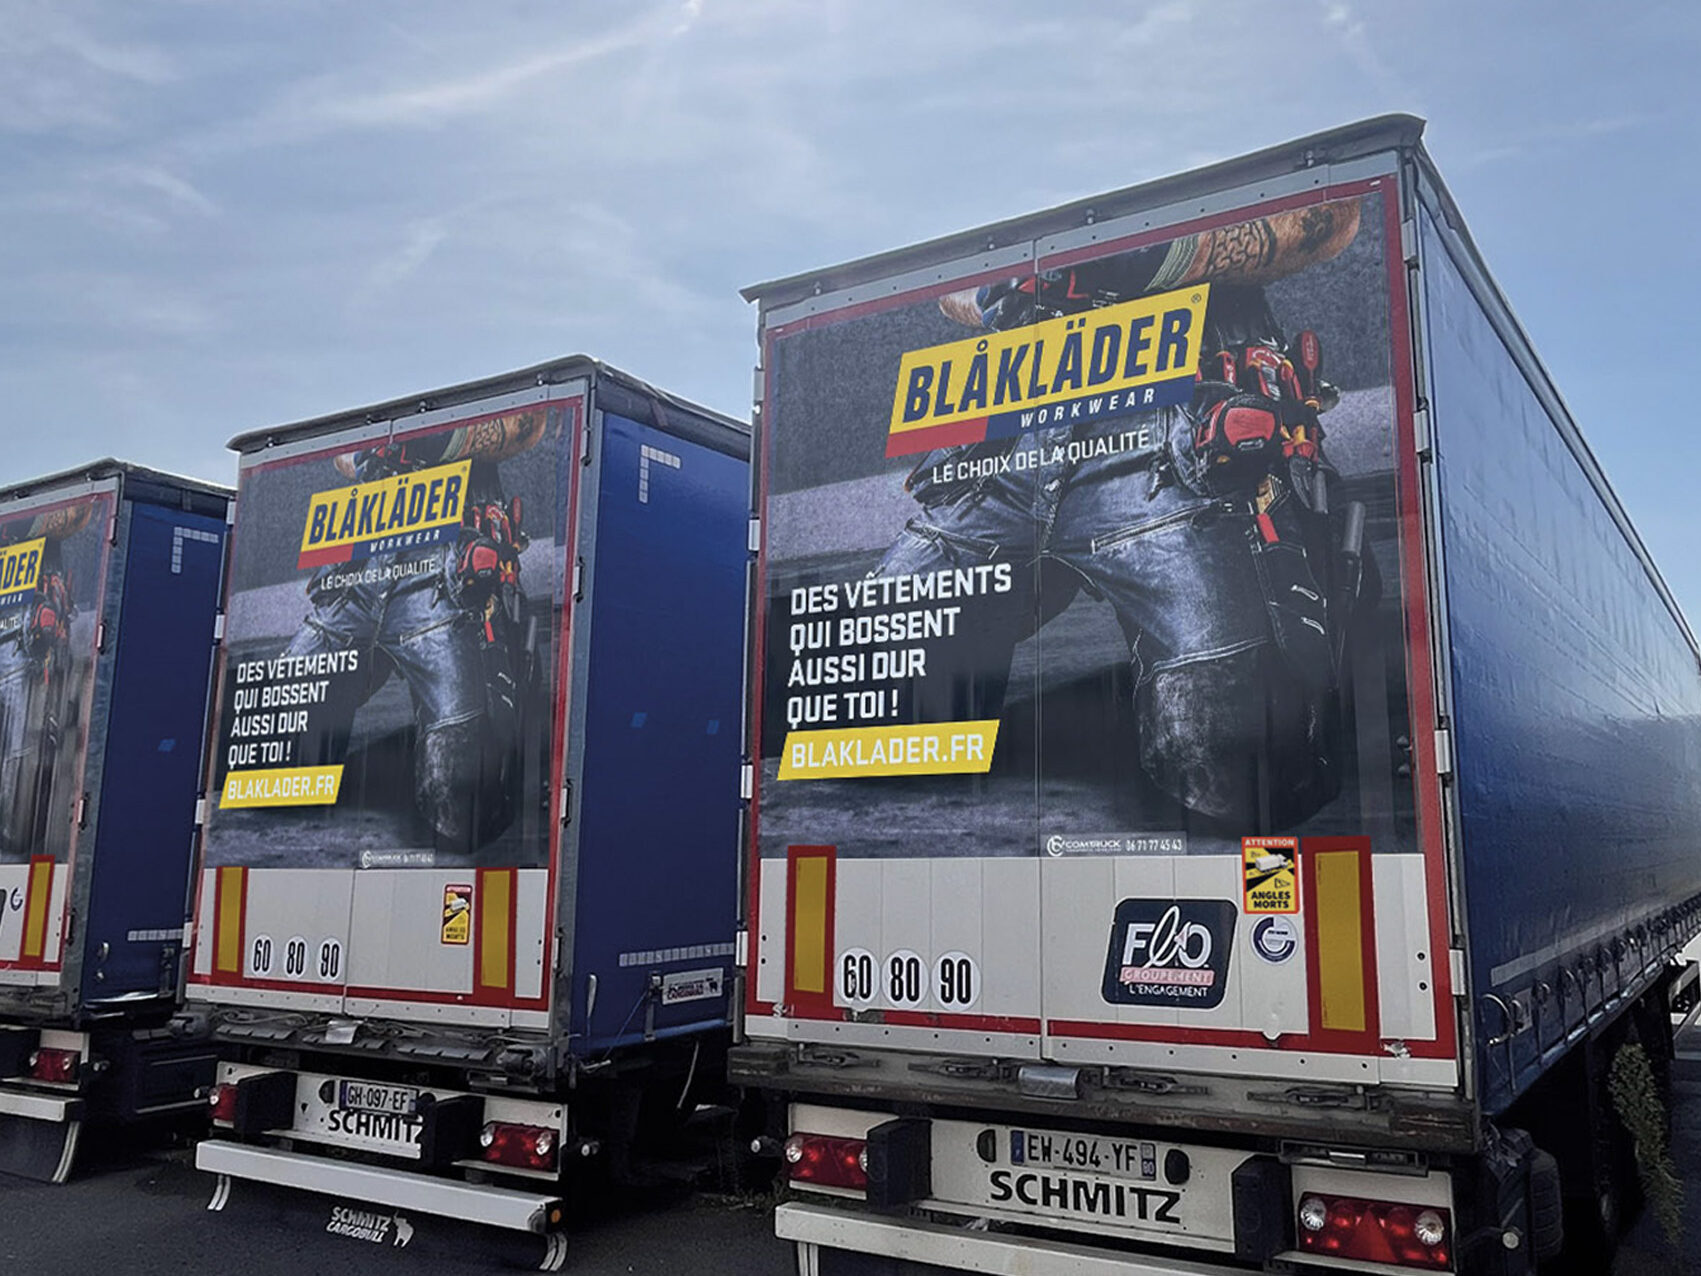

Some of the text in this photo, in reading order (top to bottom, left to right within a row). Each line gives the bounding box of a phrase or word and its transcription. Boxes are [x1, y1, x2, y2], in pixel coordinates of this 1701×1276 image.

[902, 308, 1193, 424] BLÅKLÄDER
[1020, 388, 1155, 428] WORKWEAR
[933, 424, 1150, 484] LE CHOIX DE LA QUALITÉ
[308, 475, 462, 545] BLÅKLÄDER
[370, 530, 440, 552] WORKWEAR
[791, 563, 1012, 615] DES VÊTEMENTS
[790, 607, 961, 656] QUI BOSSENT
[236, 661, 264, 683] DES
[788, 648, 926, 687] AUSSI DUR
[234, 681, 329, 714] QUI BOSSENT
[787, 694, 837, 729] QUE
[843, 690, 884, 720] TOI
[230, 711, 308, 738] AUSSI DUR
[228, 744, 257, 769] QUE
[260, 741, 284, 763] TOI
[791, 734, 984, 768] BLAKLADER.FR
[227, 775, 335, 800] BLAKLADER.FR
[1245, 838, 1295, 846] ATTENTION
[1251, 891, 1291, 900] ANGLES
[1253, 900, 1289, 909] MORTS
[253, 939, 271, 972] 60
[286, 941, 305, 975] 80
[320, 943, 340, 977] 90
[844, 954, 872, 999] 60
[890, 957, 920, 1002] 80
[940, 958, 971, 1004] 90
[1124, 969, 1212, 985] GROUPEMENT
[1129, 984, 1208, 997] L'ENGAGEMENT
[990, 1170, 1181, 1224] SCHMITZ
[331, 1206, 392, 1232] SCHMITZ
